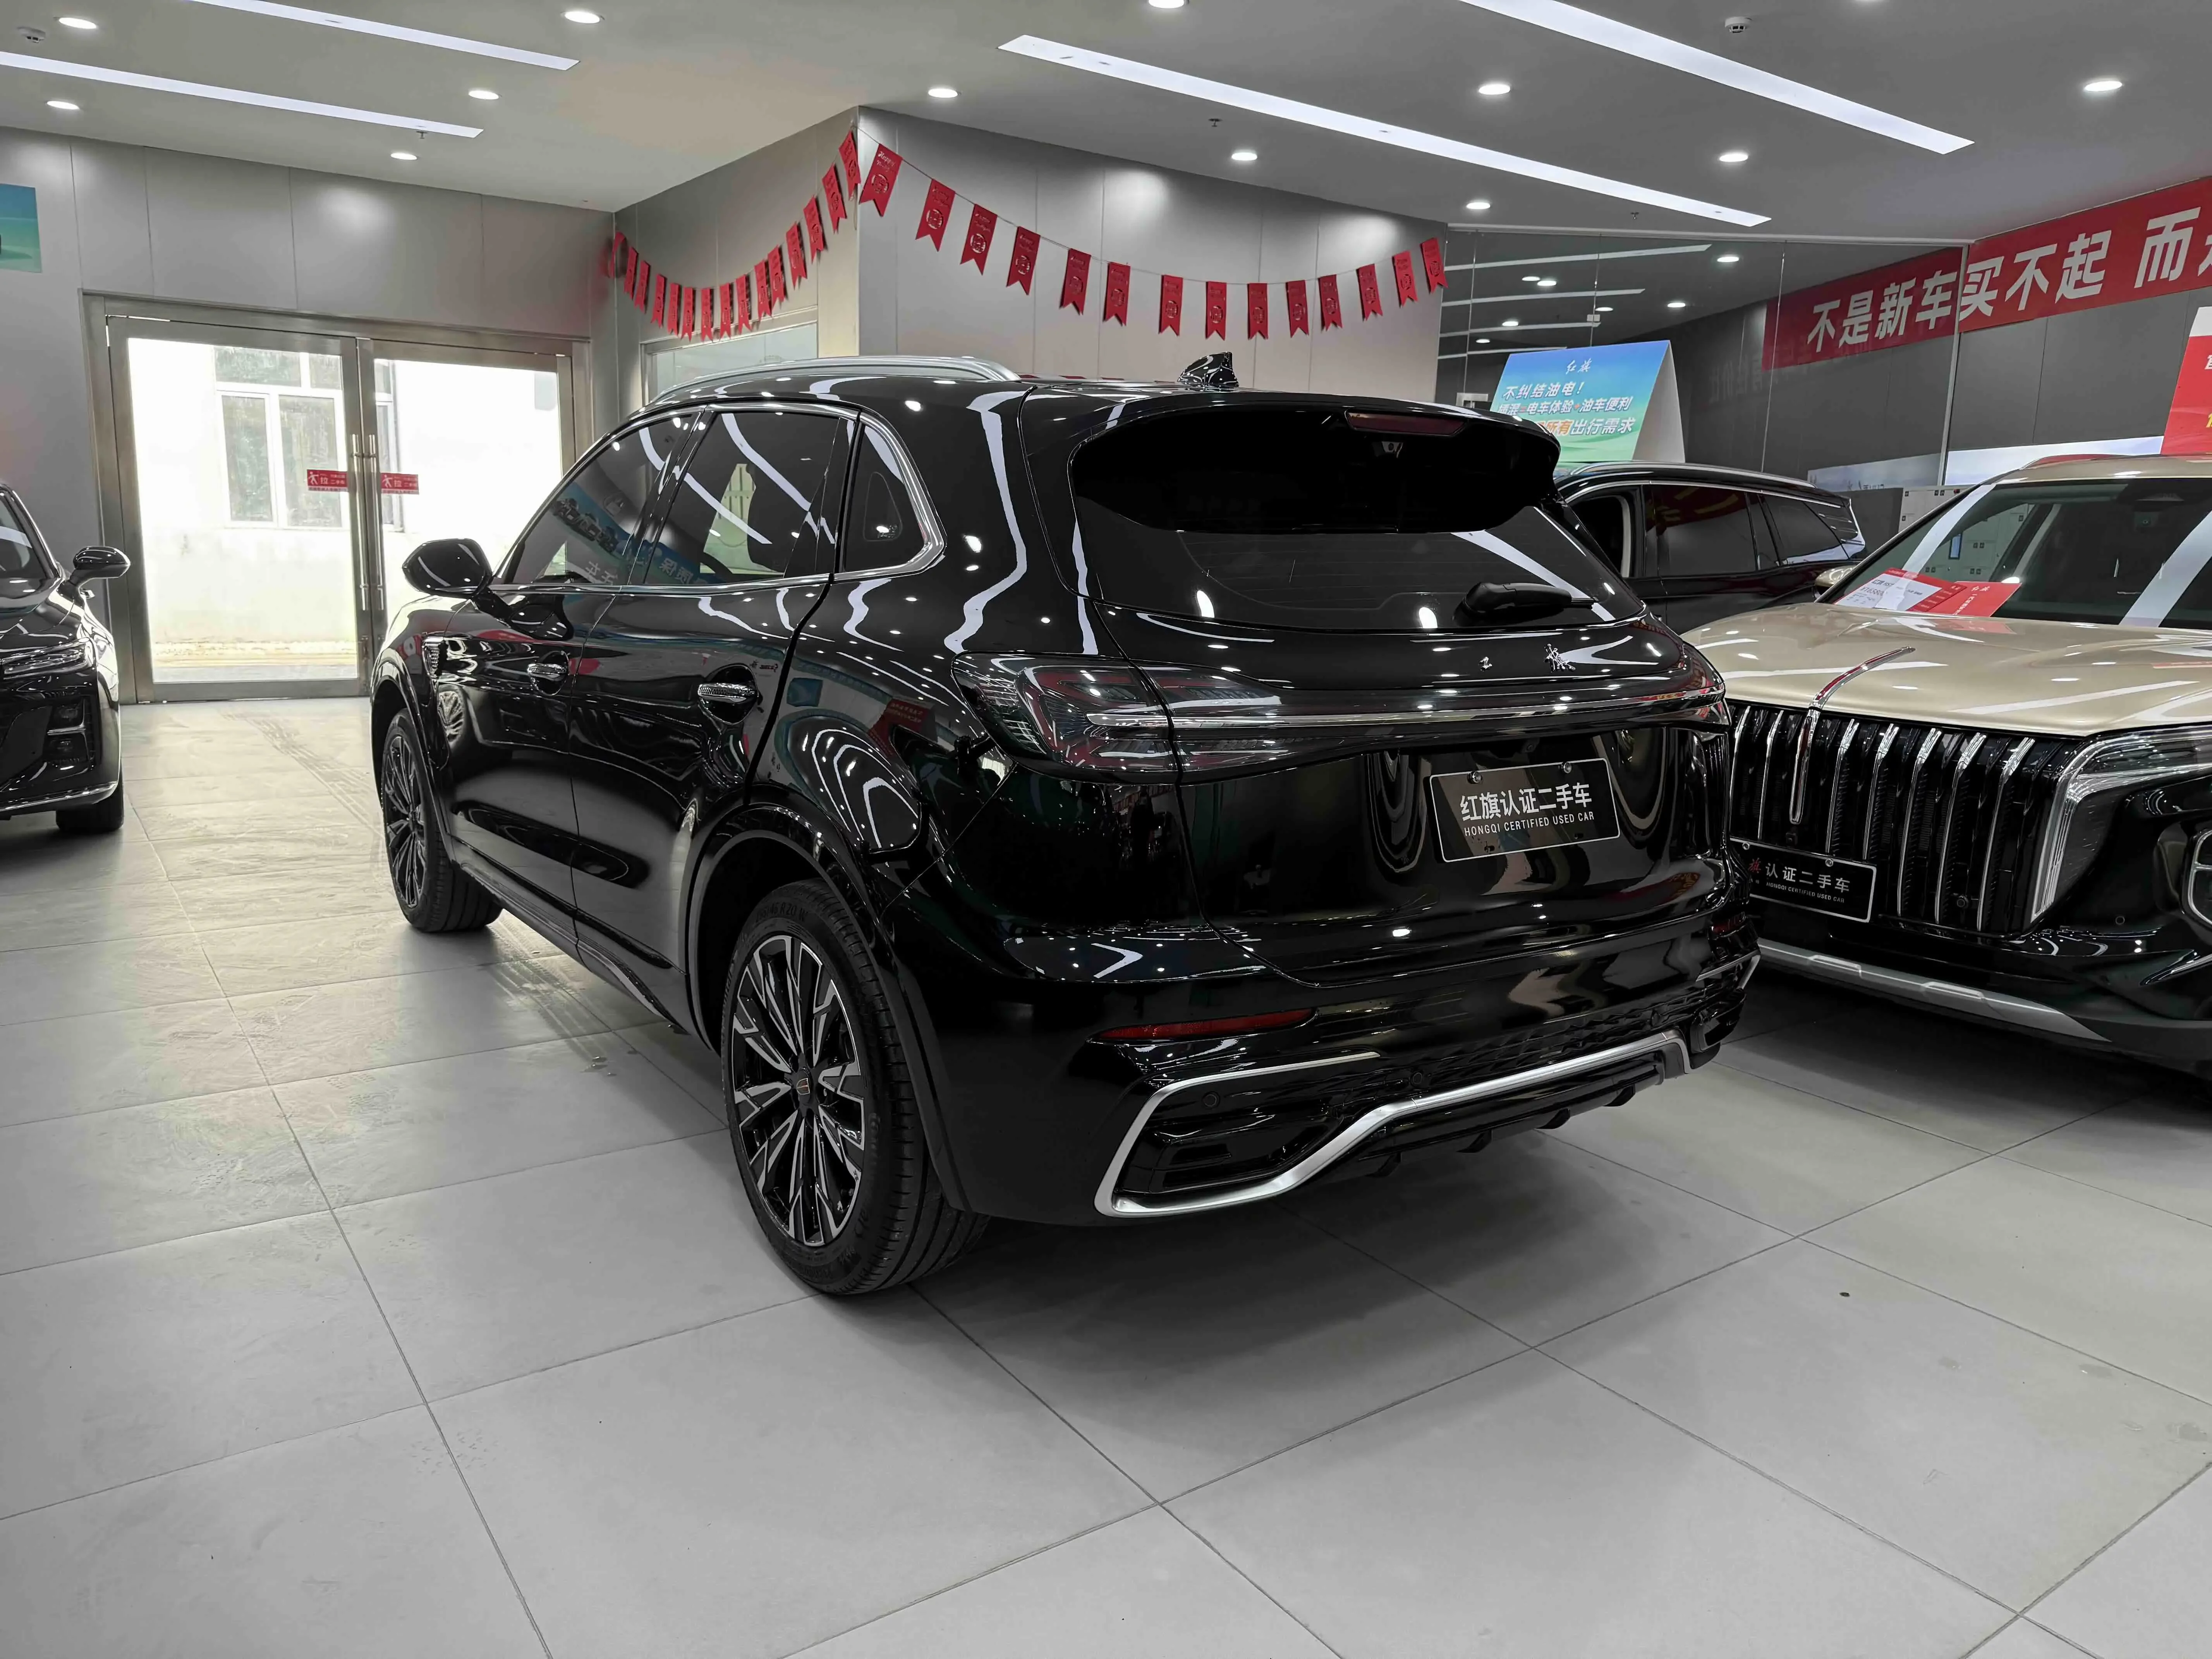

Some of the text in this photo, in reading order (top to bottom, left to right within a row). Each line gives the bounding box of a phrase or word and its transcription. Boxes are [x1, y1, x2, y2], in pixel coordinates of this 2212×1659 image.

[1807, 207, 2212, 353] 不是新车买不起 而
[1566, 358, 1592, 374] 红旗
[1537, 417, 1636, 436] 所有出行需求
[1460, 782, 1592, 821] 红旗认证二手车
[1464, 811, 1595, 836] HONGQI CERTIFIED USED CAR
[1766, 882, 1787, 891] HONGQI
[1788, 886, 1816, 897] CERTIFIED
